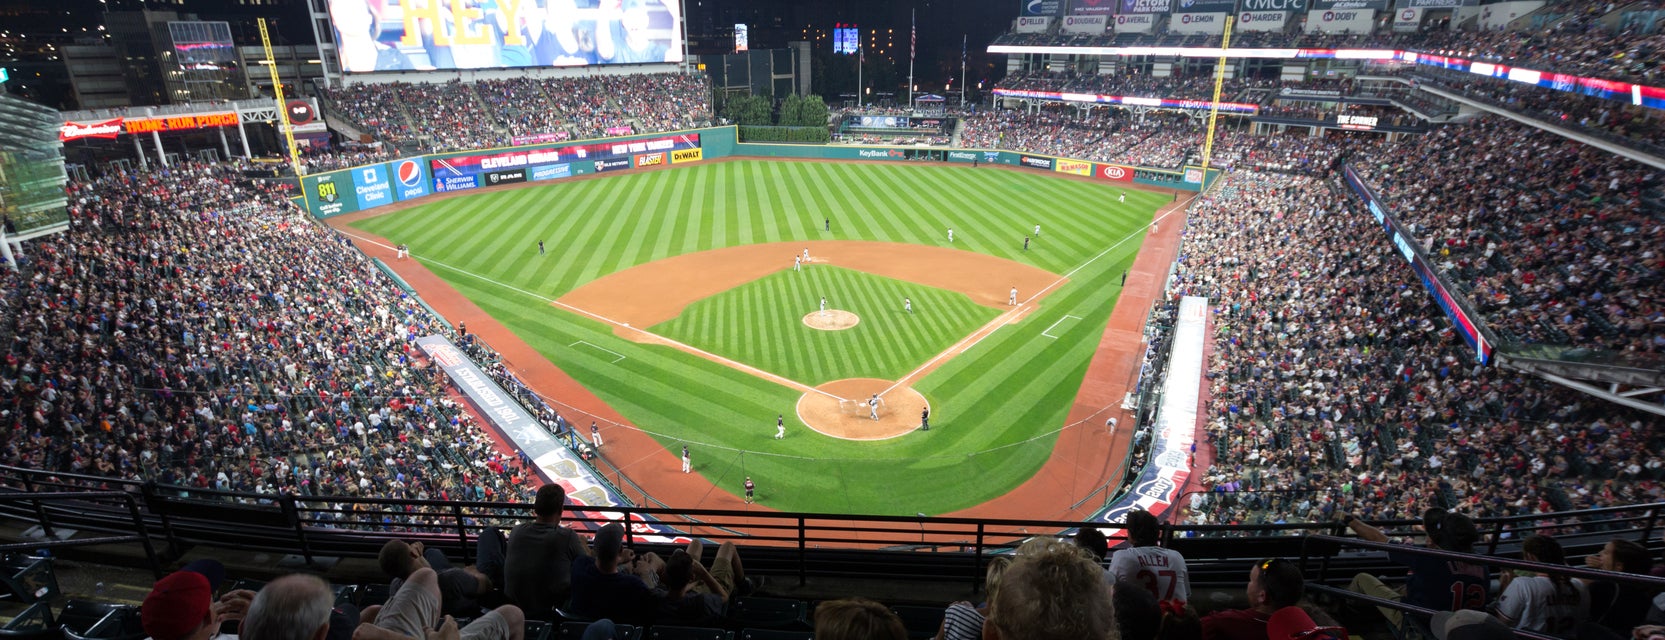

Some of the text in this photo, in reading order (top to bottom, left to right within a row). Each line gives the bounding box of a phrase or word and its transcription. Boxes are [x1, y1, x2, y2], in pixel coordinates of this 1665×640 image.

[401, 0, 525, 46] HEY
[1074, 17, 1103, 25] BOUDREAU
[1126, 16, 1150, 24] AVERILL
[1191, 14, 1214, 23] LEMON
[1251, 13, 1283, 22] HARDER
[1334, 12, 1358, 21] DOBY
[125, 112, 239, 134] HOME RUN PORCH
[1336, 114, 1379, 126] THE CORNER
[59, 124, 121, 138] Budweiser
[611, 139, 674, 155] NEW YORK YANKEES
[859, 149, 888, 158] KeyBank
[481, 151, 559, 169] CLEVELAND INDIANS
[638, 154, 662, 167] BLASTER
[500, 172, 523, 180] RAM
[533, 164, 570, 179] PROGRESSIVE
[1107, 168, 1122, 177] KIA
[445, 175, 474, 185] SHERWIN
[318, 182, 336, 197] 811
[356, 181, 389, 195] Cleveland
[404, 186, 423, 197] pepsi
[365, 191, 385, 202] Clinic
[455, 367, 504, 408] ESTABLISHED
[1146, 477, 1173, 498] 2007
[1137, 555, 1169, 568] ALLEN
[1136, 569, 1178, 601] 37
[1450, 580, 1486, 612] 12
